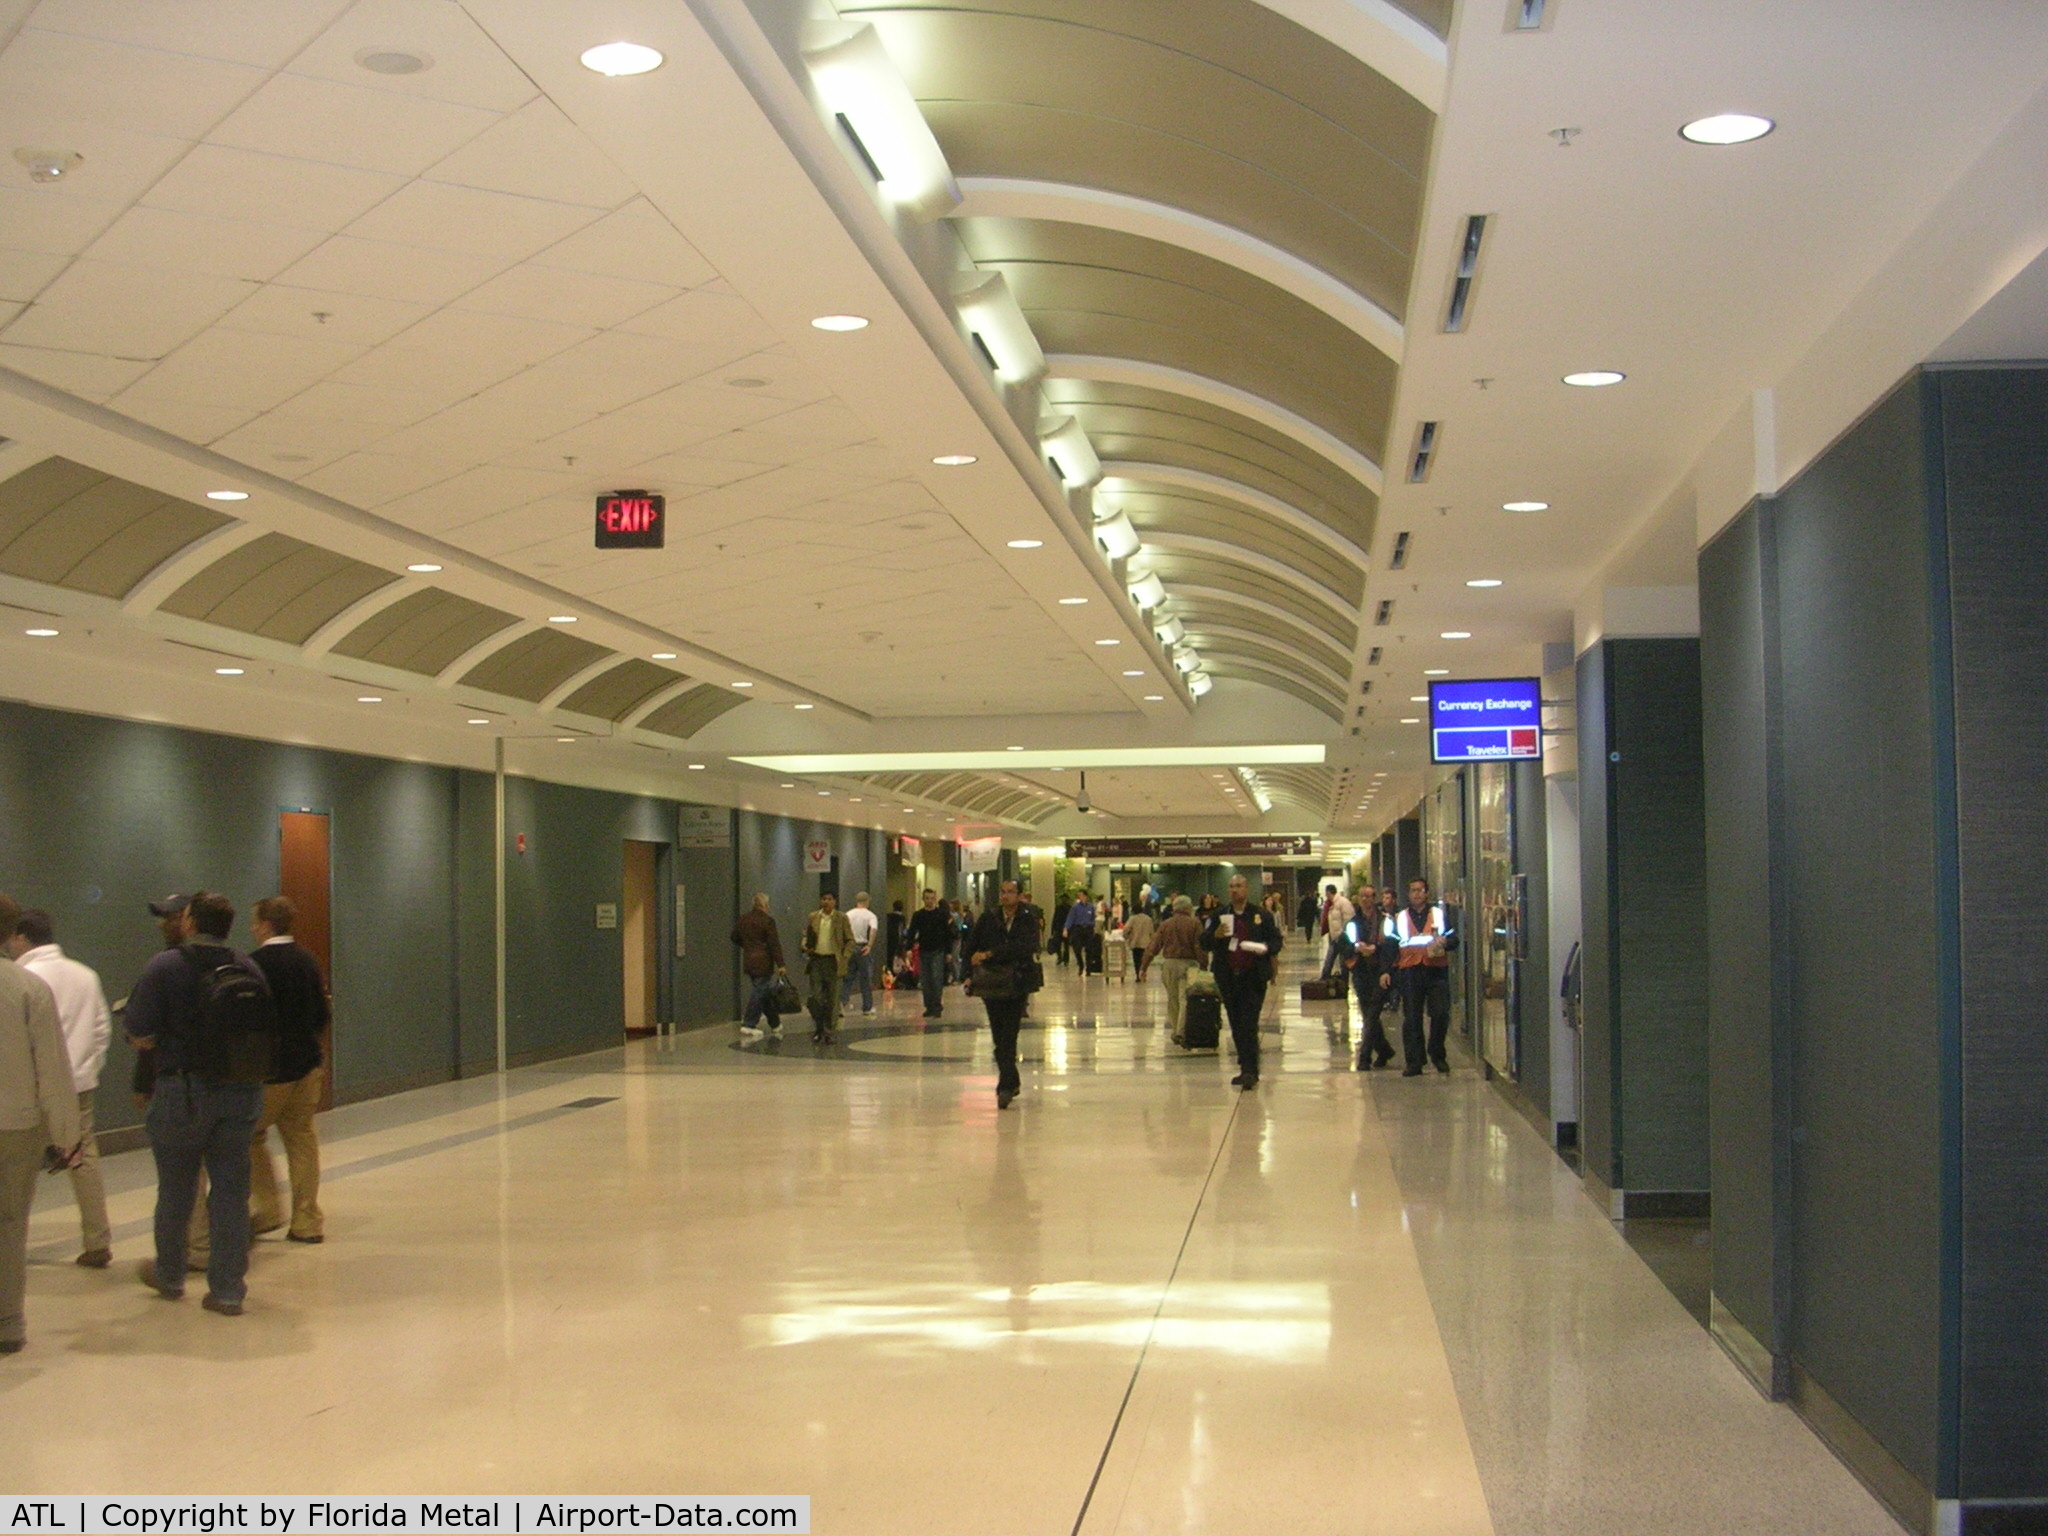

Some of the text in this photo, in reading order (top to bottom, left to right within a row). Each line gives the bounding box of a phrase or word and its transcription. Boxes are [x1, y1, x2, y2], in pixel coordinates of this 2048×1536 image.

[606, 498, 653, 533] EXIT
[1438, 698, 1533, 712] Currency Exchange
[1466, 744, 1508, 756] Travelex
